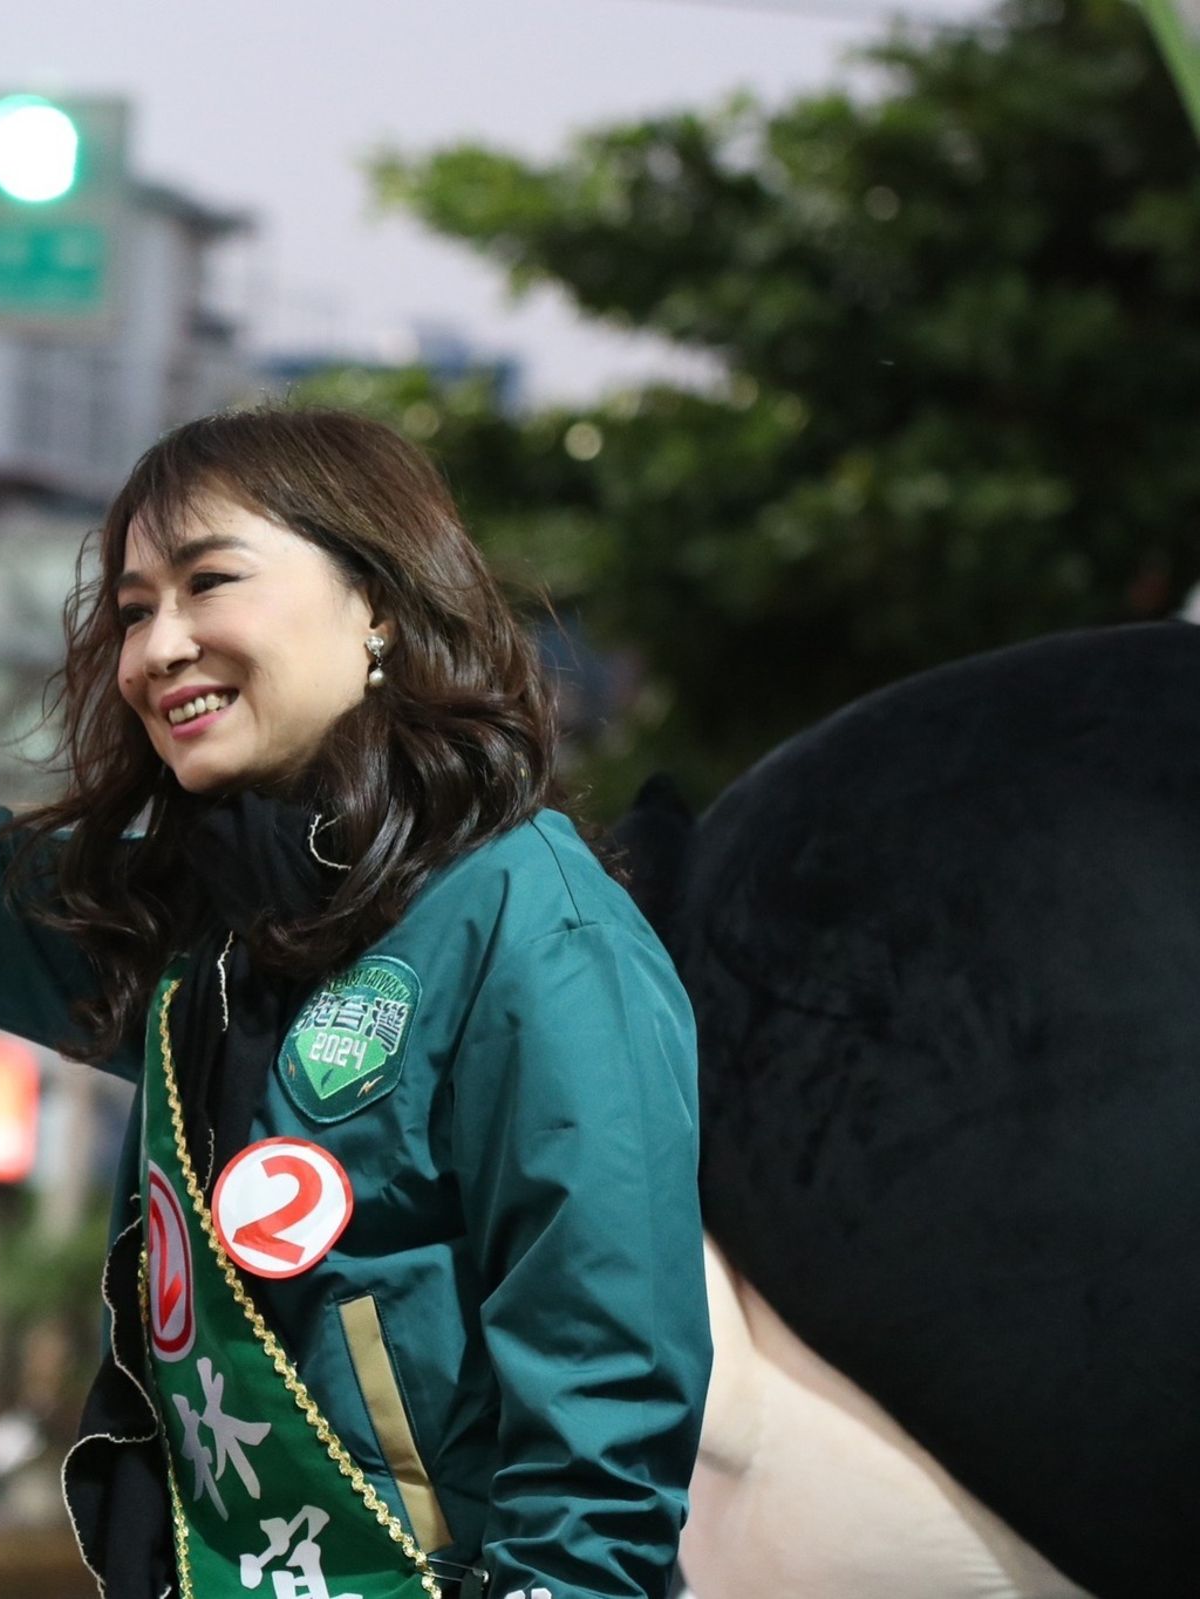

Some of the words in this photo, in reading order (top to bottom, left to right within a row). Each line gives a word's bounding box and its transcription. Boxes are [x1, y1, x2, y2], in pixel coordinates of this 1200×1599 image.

[364, 966, 411, 1003] TAIWAN
[309, 1032, 368, 1071] 2024
[232, 1155, 323, 1265] 2
